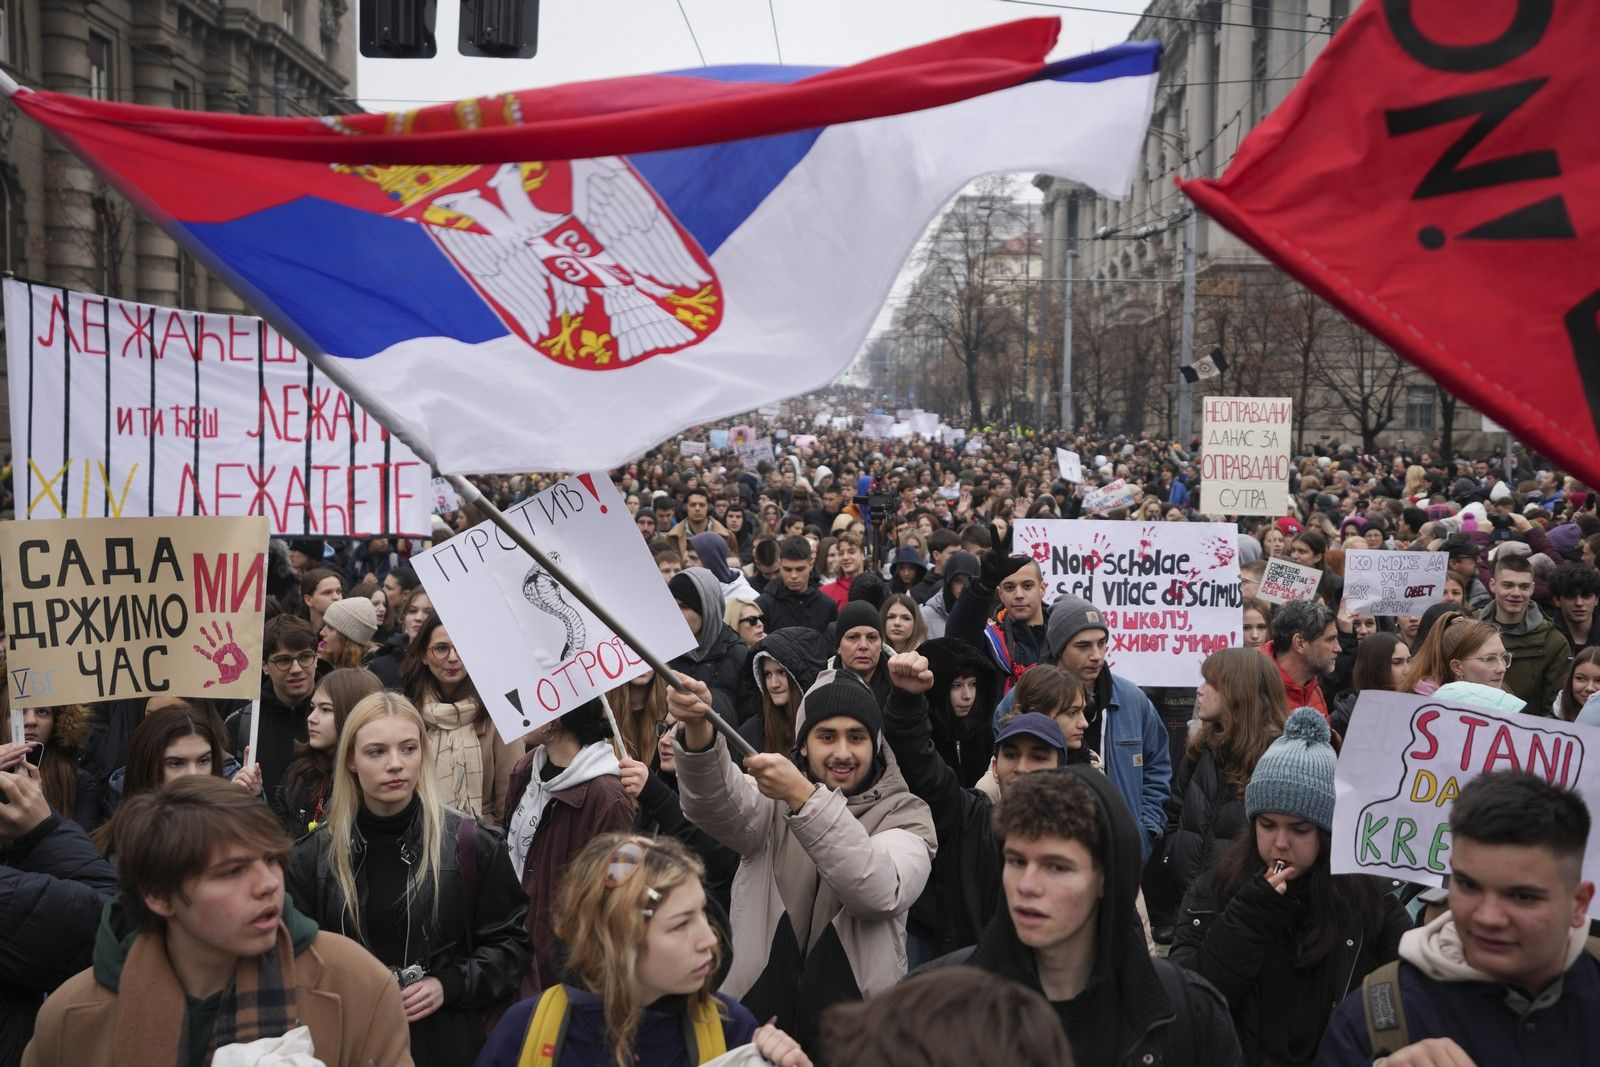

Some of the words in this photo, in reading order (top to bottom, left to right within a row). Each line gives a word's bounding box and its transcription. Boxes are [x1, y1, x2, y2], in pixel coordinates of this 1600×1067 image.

[1205, 401, 1290, 424] НЕОПРАВДАНИ
[1208, 429, 1255, 447] ДАНАС
[1261, 430, 1279, 448] ЗА
[1202, 454, 1289, 480] ОПРАВДАНО
[28, 457, 139, 518] XIV
[1219, 488, 1267, 509] СУТРА
[19, 537, 184, 589] САДА
[193, 552, 265, 614] МИ
[1052, 546, 1095, 576] Non
[1378, 555, 1420, 571] МОЖЕ
[1424, 554, 1444, 572] ДА
[1056, 576, 1094, 605] sed
[1102, 577, 1158, 607] vitae
[1380, 572, 1409, 587] УЧИ
[9, 593, 189, 650] ДРЖИМО
[77, 645, 170, 697] ЧАС
[1410, 709, 1574, 789] STANI
